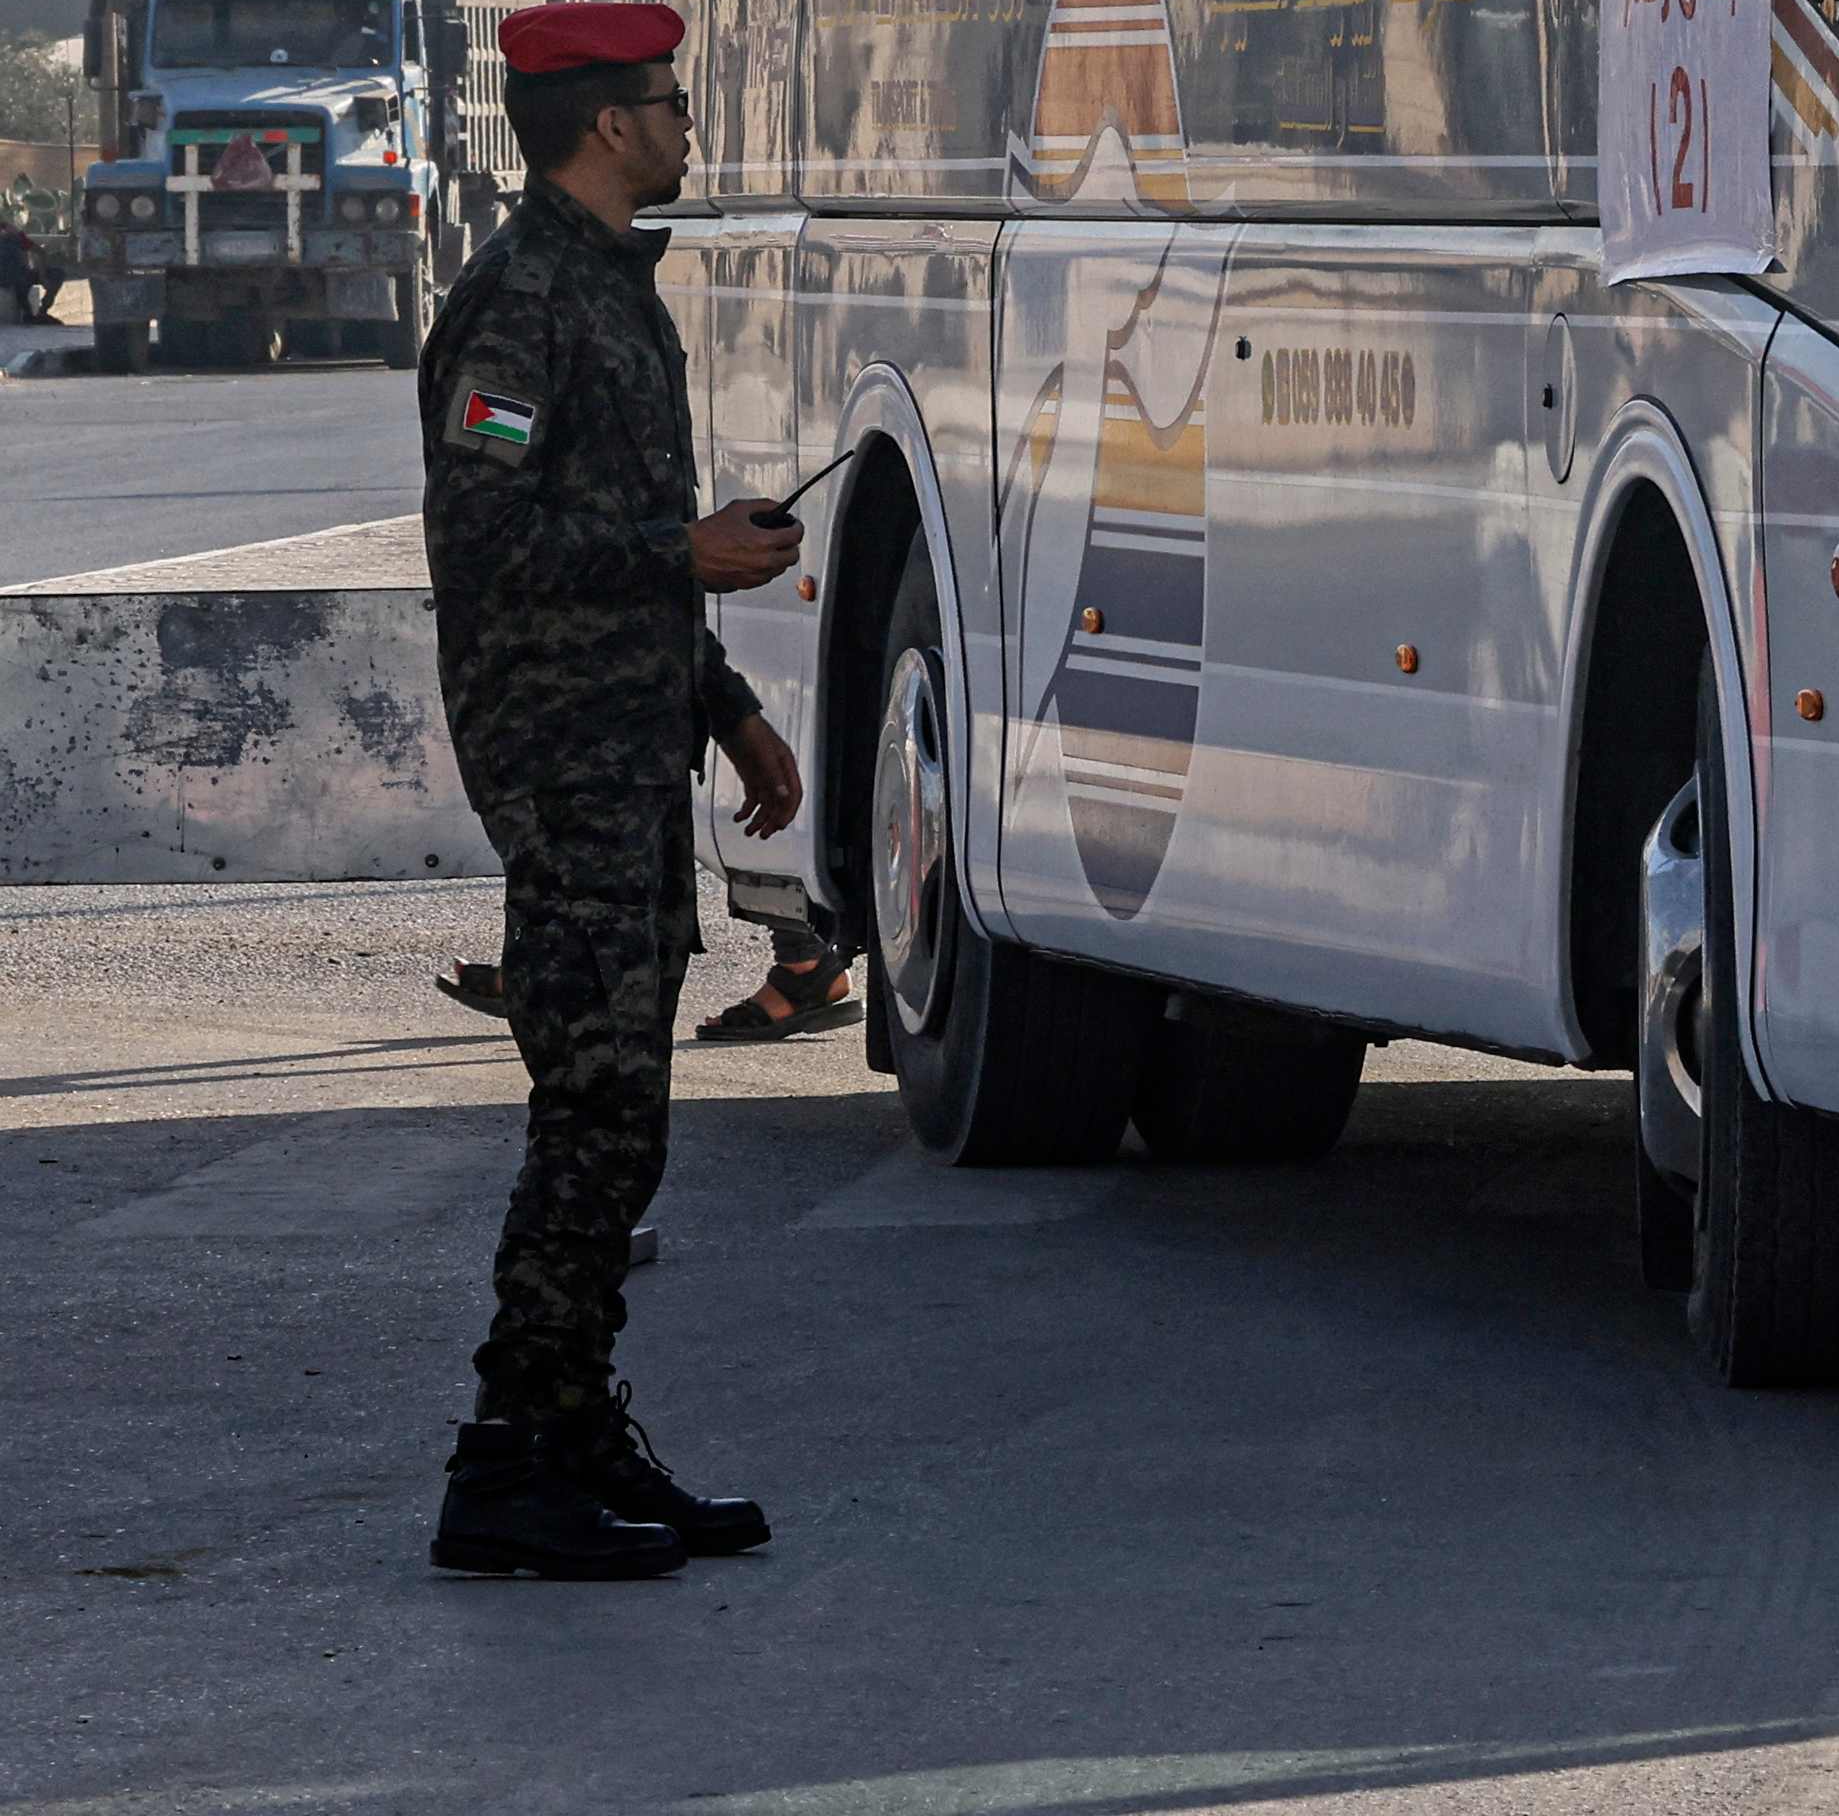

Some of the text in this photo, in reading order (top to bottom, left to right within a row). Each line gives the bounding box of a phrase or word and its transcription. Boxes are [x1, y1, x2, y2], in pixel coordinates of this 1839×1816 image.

[1650, 66, 1709, 216] (2)
[1293, 347, 1320, 426] 059
[1324, 347, 1353, 426] 888
